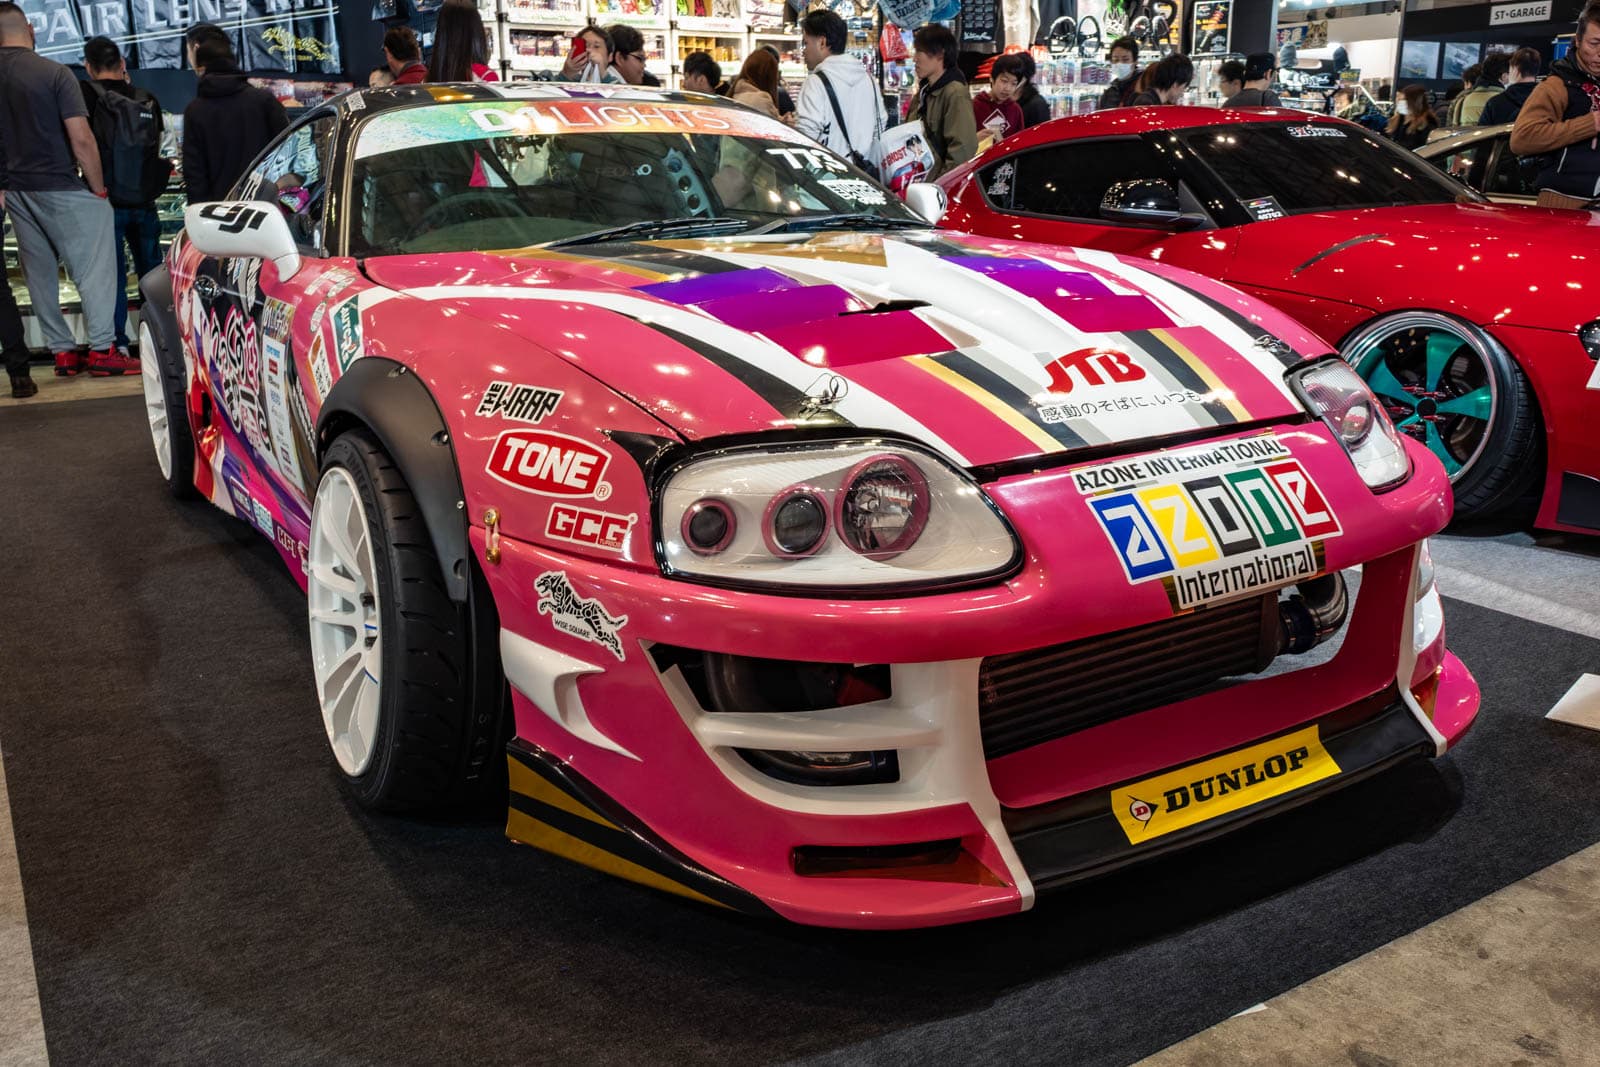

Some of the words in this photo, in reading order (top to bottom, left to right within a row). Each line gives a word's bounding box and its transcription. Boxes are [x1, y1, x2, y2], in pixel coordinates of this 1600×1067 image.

[1043, 347, 1146, 394] JTB
[478, 383, 503, 413] THE
[502, 437, 598, 490] TONE
[1076, 463, 1146, 491] AZONE
[1144, 439, 1287, 477] INTERNATIONAL
[548, 507, 629, 547] GCG
[1177, 544, 1316, 605] International
[1163, 746, 1309, 814] DUNLOP
